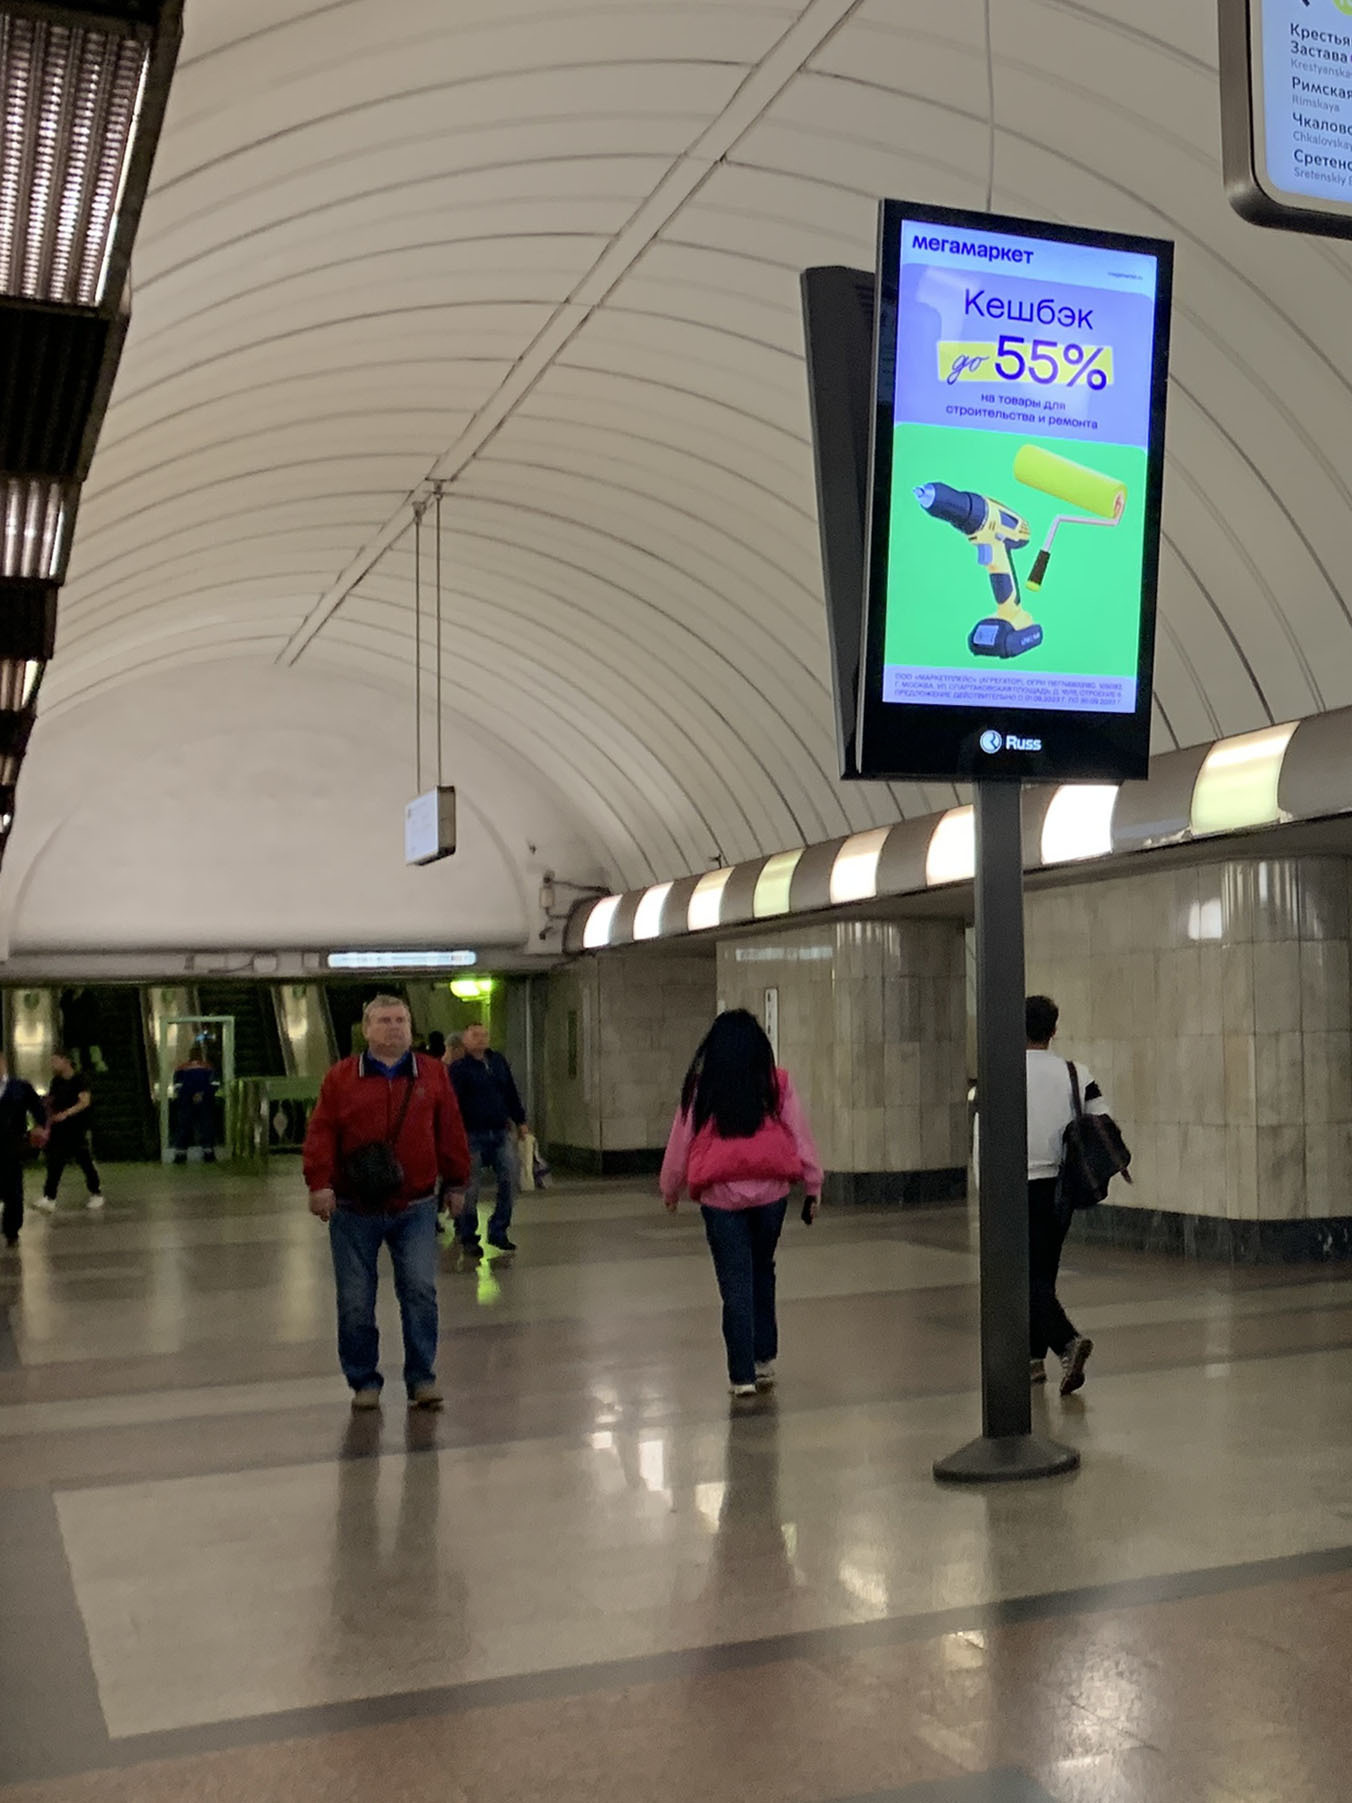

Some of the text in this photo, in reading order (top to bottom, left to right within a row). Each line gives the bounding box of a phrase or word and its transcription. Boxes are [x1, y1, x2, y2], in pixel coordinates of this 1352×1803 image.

[1290, 41, 1348, 63] Застава
[1292, 95, 1340, 112] Rimskaya
[1294, 166, 1347, 186] Sretenskiy
[912, 235, 1034, 264] мегамаркет
[964, 288, 1094, 330] Кешбэк
[995, 335, 1107, 391] 55%
[981, 394, 1066, 411] на товары для
[945, 405, 1098, 429] строительства и ремонта
[1005, 735, 1042, 751] Russ
